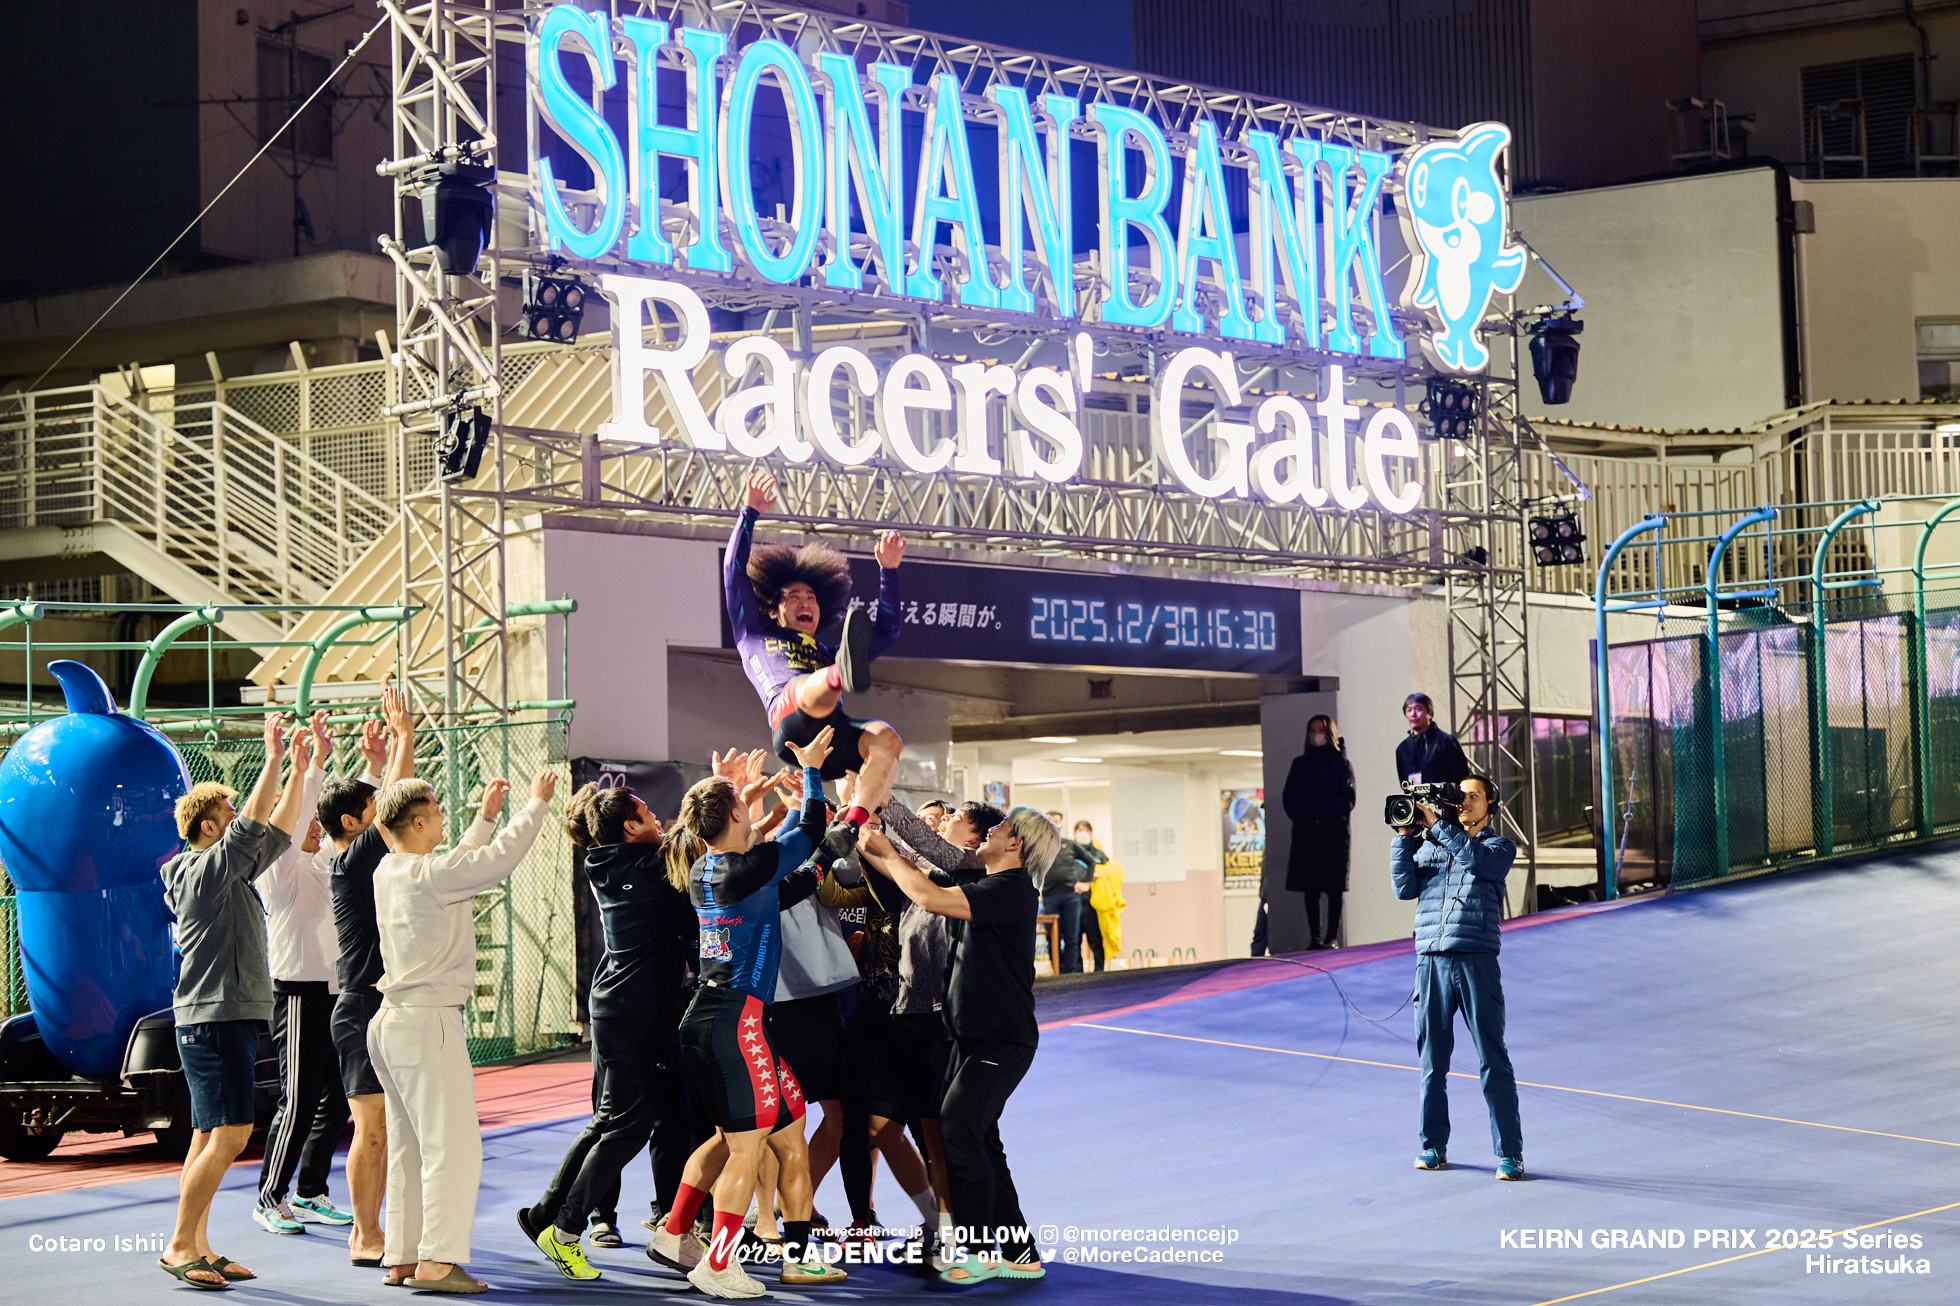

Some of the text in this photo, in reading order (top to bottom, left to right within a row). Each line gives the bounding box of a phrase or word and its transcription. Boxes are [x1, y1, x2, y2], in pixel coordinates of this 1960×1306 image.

[536, 3, 1405, 360] SHONAN BANK
[597, 273, 1424, 514] Racers' Gate
[847, 596, 1002, 630] 生をえる瞬間が。
[1030, 597, 1277, 651] 2025.12/30.16:30
